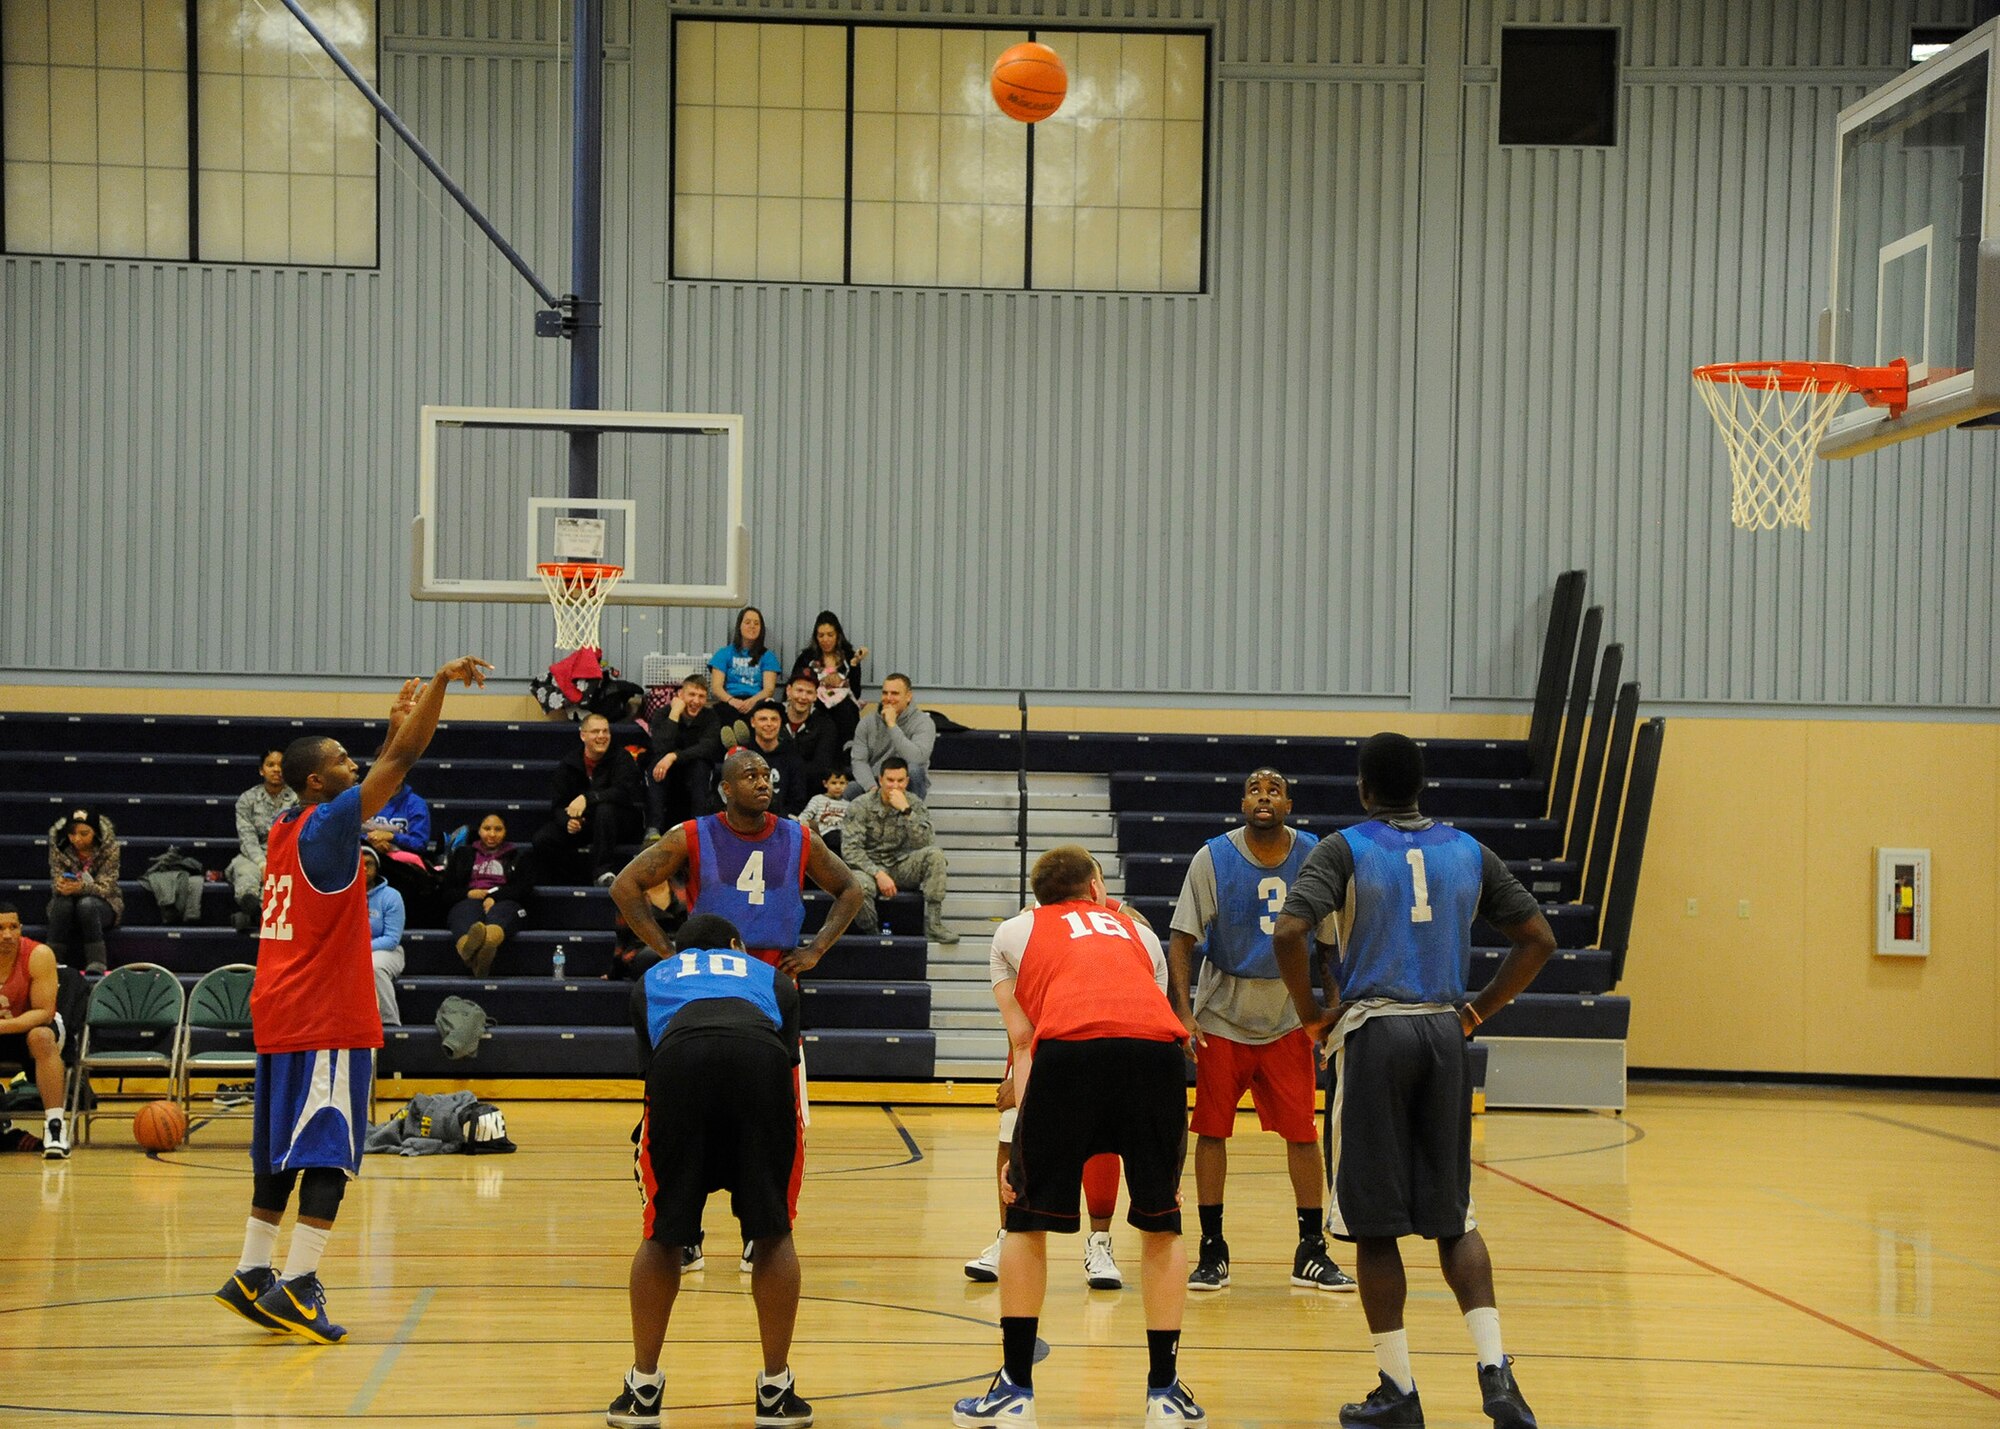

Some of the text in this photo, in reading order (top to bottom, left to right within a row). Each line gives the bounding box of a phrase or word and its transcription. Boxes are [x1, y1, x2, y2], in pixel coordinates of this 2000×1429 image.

[736, 850, 766, 905] 4
[1257, 876, 1288, 935] 3
[1406, 848, 1432, 923] 1
[260, 873, 293, 941] 22
[1060, 911, 1131, 940] 16
[676, 952, 748, 978] 10
